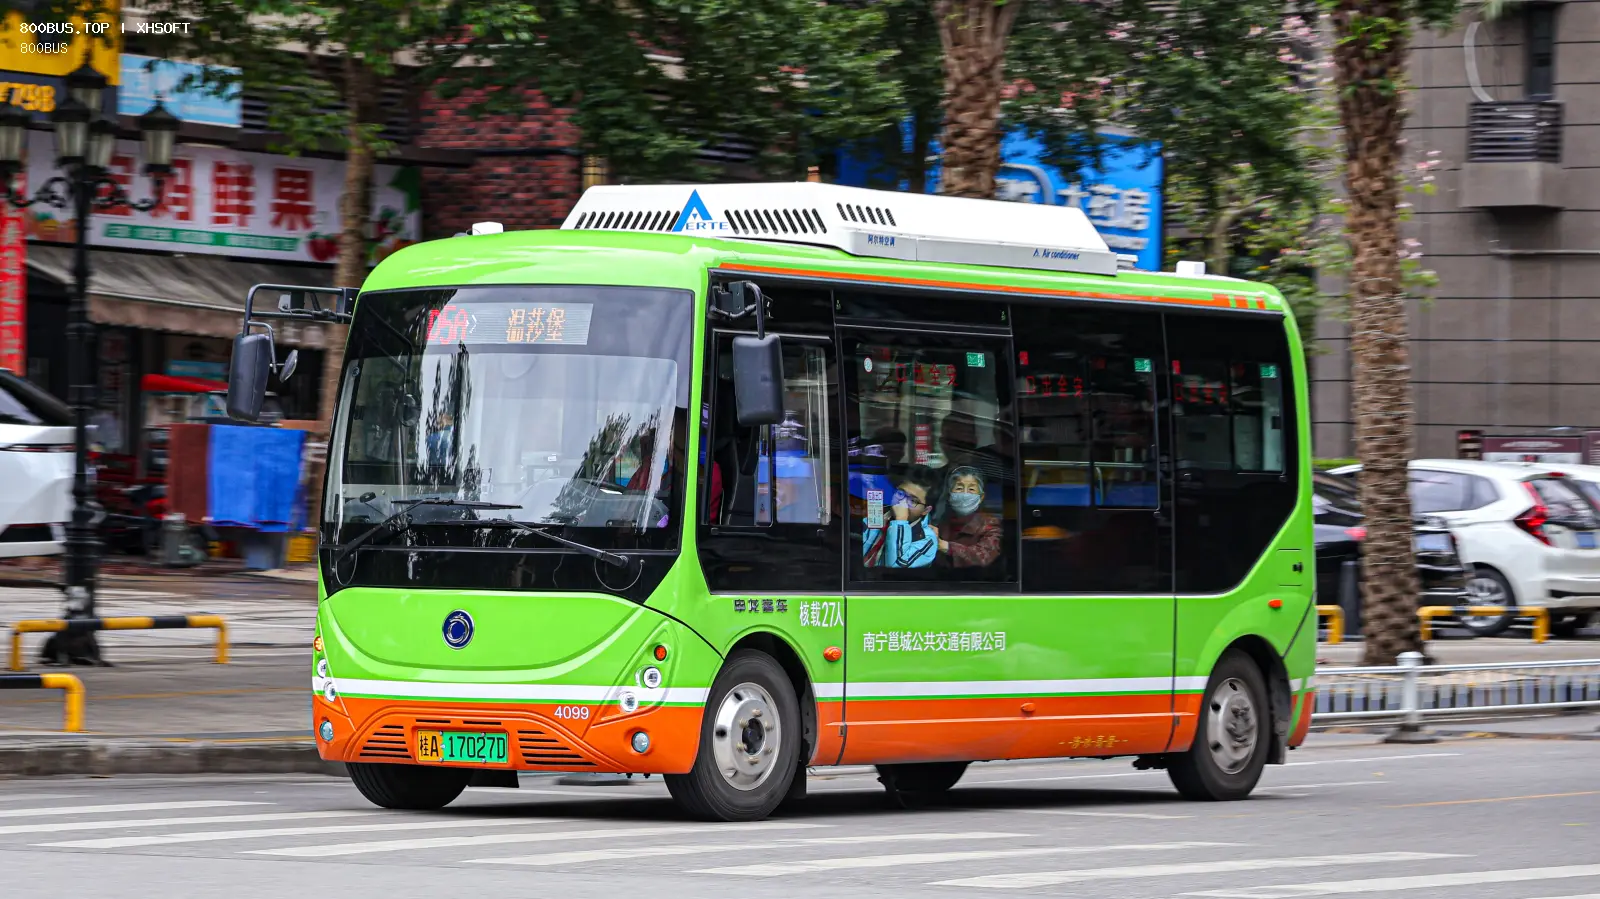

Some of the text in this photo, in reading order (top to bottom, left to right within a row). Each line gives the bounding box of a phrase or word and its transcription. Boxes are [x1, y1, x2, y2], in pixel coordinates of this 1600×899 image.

[505, 307, 566, 343] 温莎堡
[799, 600, 845, 628] 核载27人
[862, 631, 1006, 652] 南宁邕城公共交通有限公司
[554, 705, 590, 720] 4099
